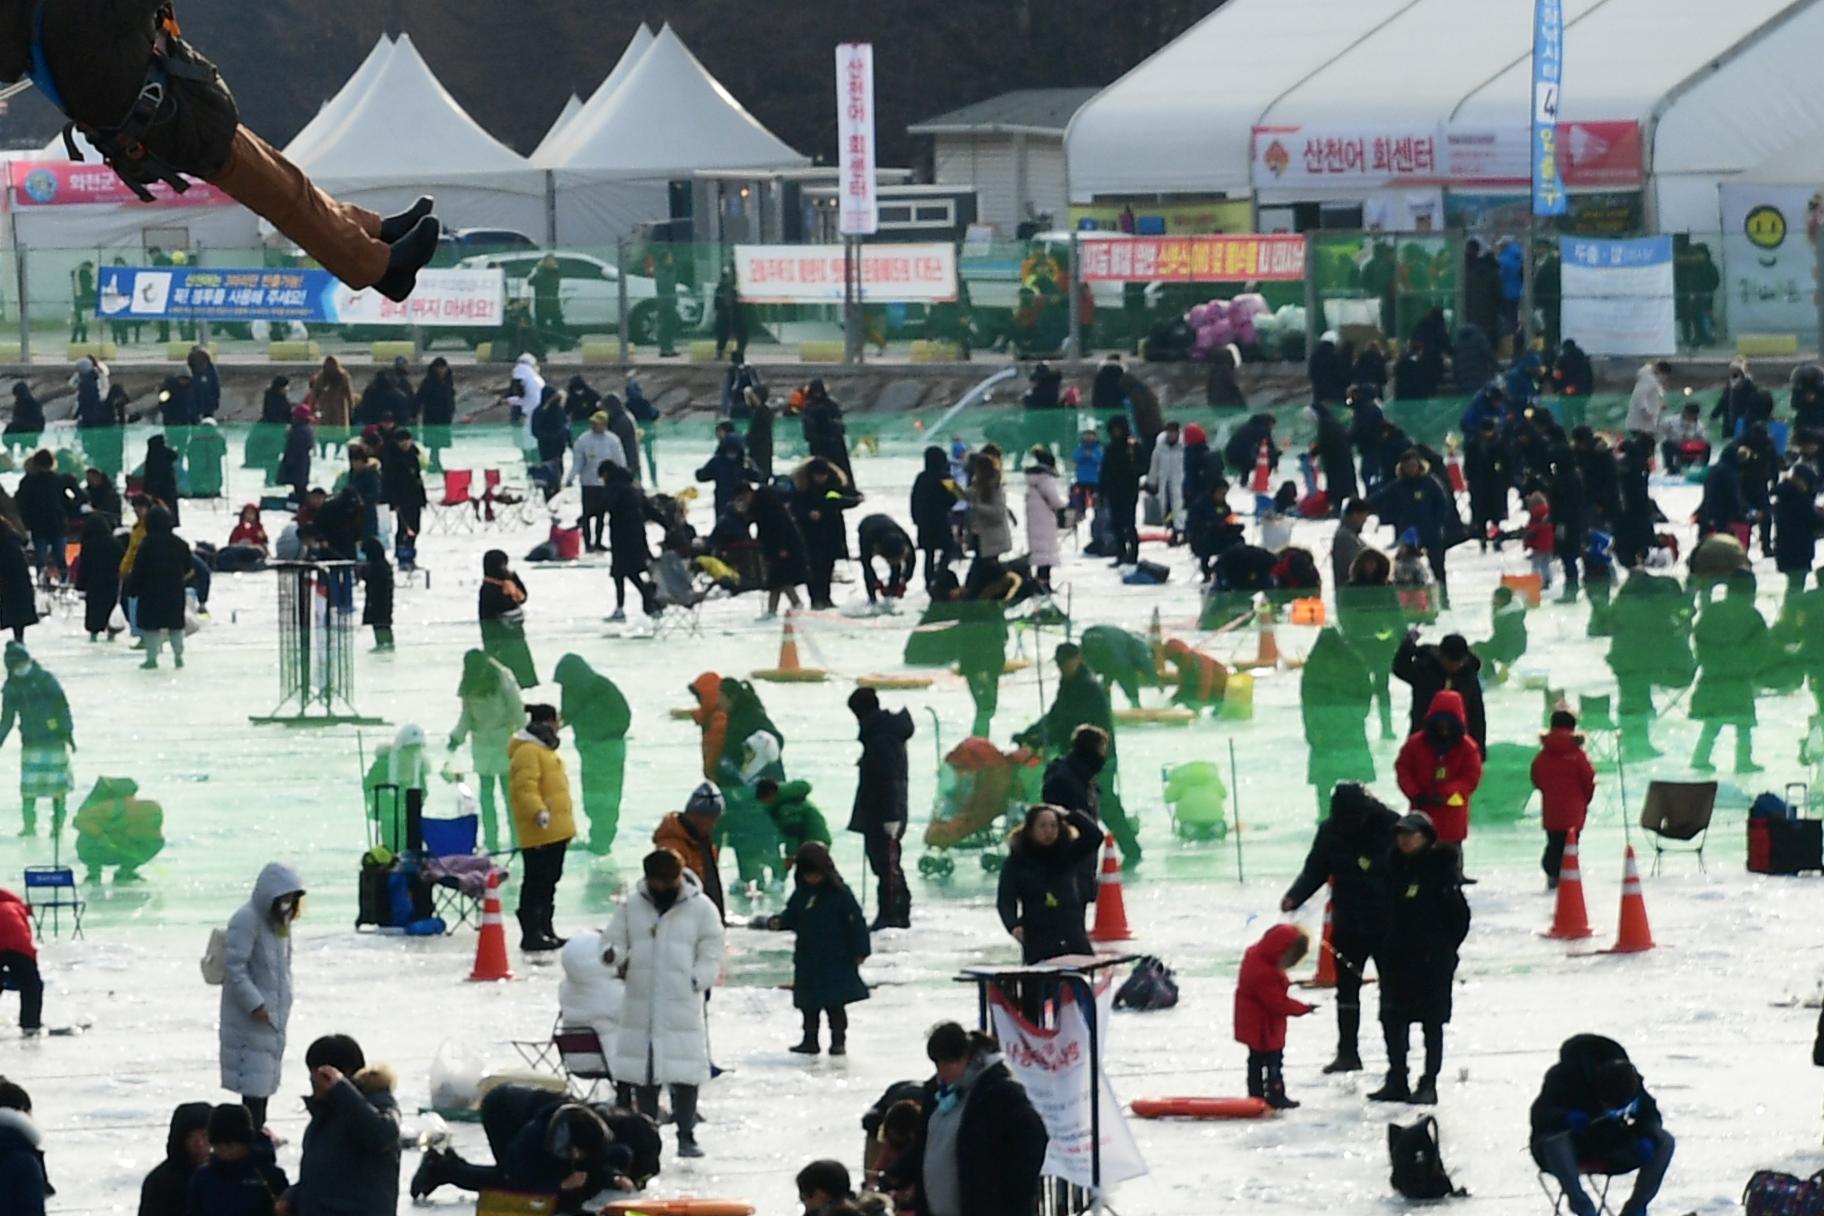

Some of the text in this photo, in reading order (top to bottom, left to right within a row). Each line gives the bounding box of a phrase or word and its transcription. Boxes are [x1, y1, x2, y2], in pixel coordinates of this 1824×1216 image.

[847, 58, 866, 123] 산천어
[1543, 89, 1557, 120] 4
[1302, 138, 1365, 175] 산천어
[1372, 135, 1435, 173] 회센터
[69, 172, 115, 192] 화천군
[228, 288, 265, 305] 사용해
[266, 288, 308, 306] 주세요!
[444, 297, 495, 319] 마세요!
